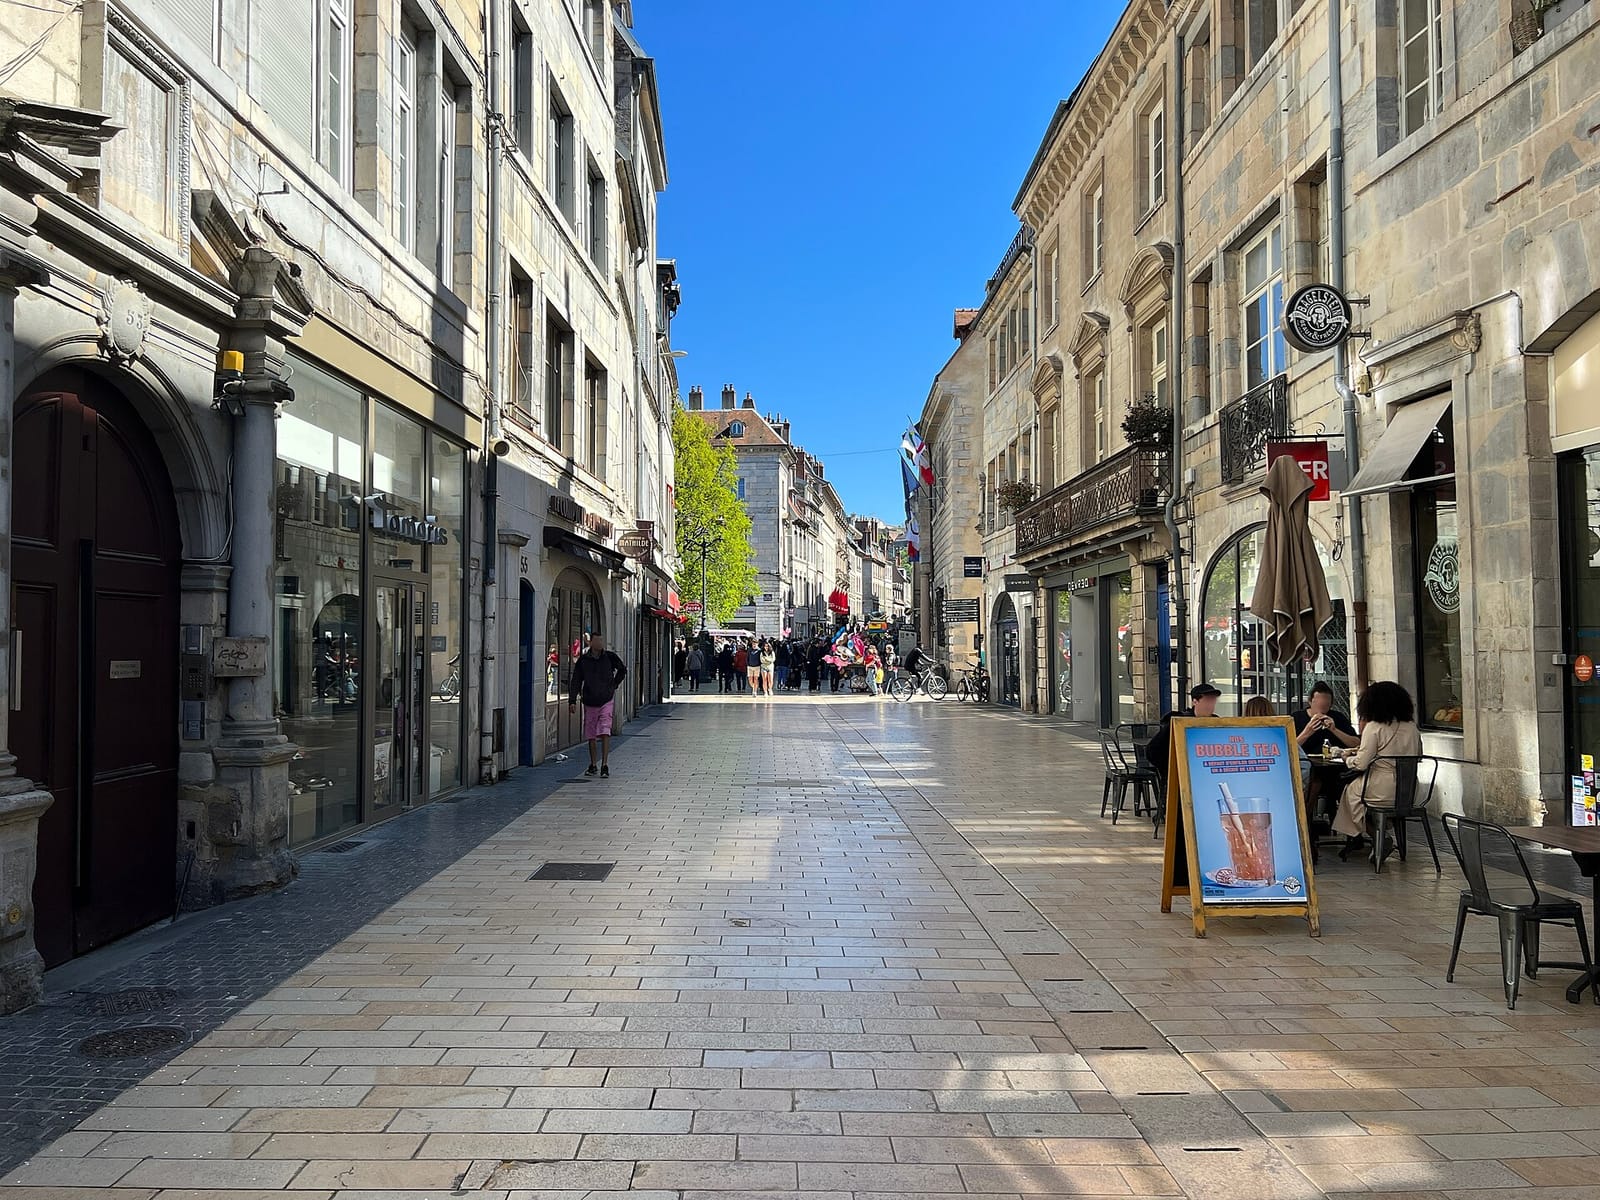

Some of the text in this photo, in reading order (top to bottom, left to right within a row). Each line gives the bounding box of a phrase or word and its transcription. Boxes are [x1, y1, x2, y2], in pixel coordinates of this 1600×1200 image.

[1297, 291, 1342, 317] BAGELSTEIN
[126, 309, 143, 330] 53
[520, 555, 528, 574] 55
[1195, 743, 1281, 757] BUBBLE TEA
